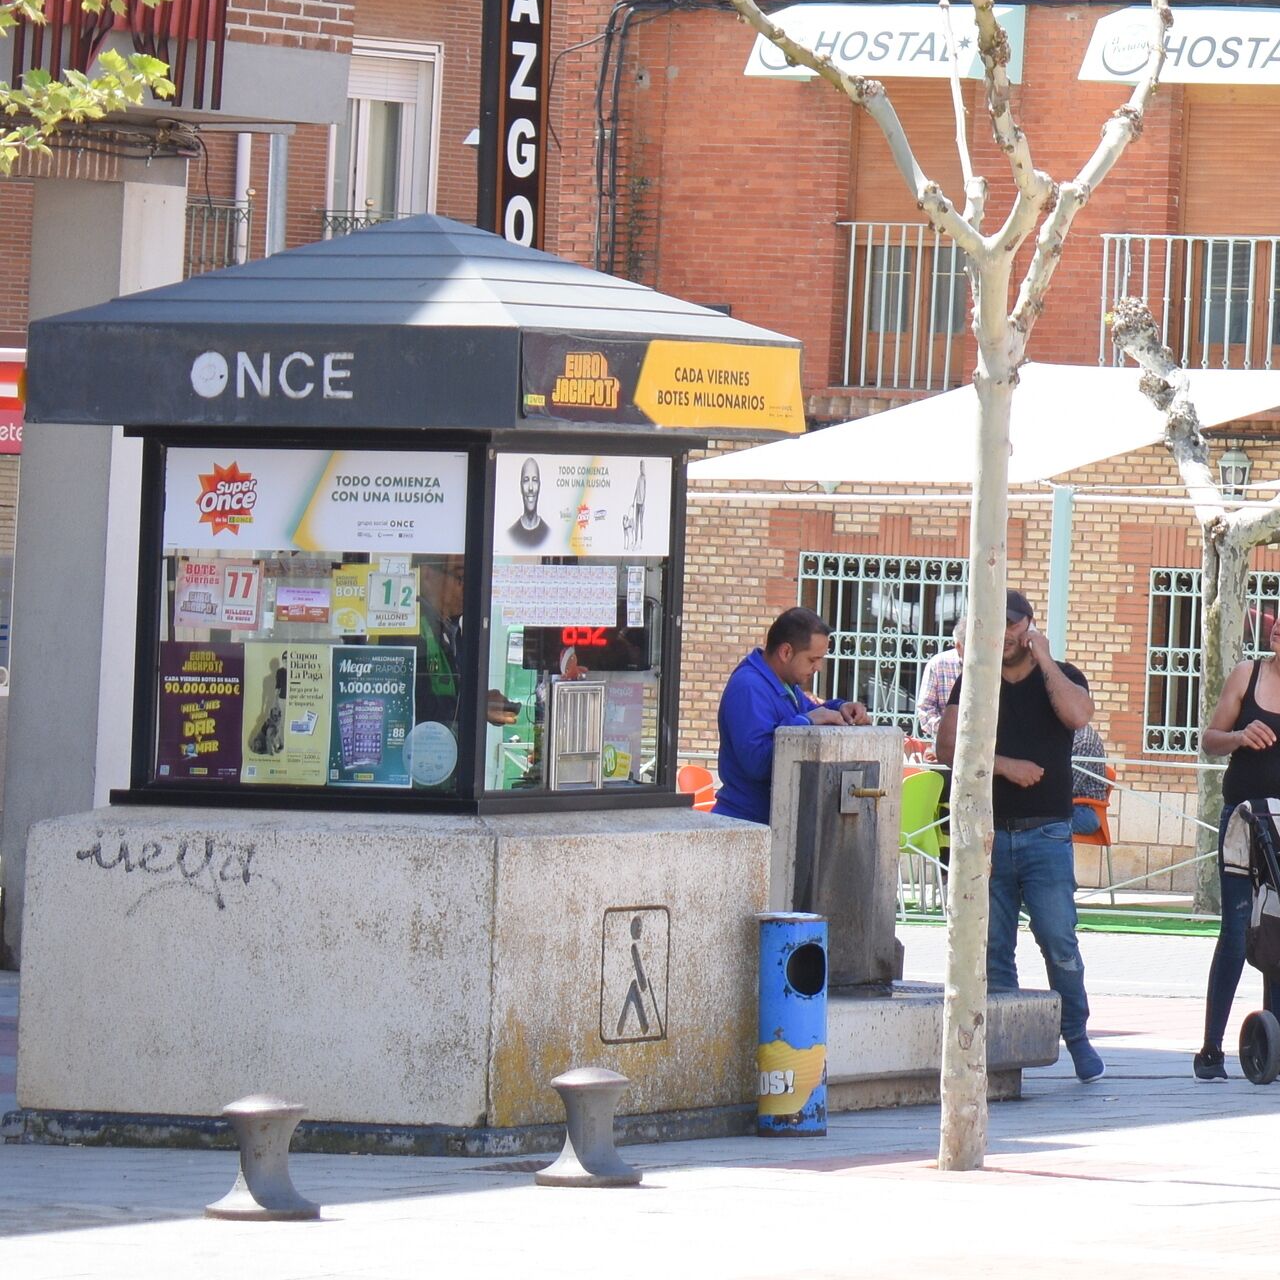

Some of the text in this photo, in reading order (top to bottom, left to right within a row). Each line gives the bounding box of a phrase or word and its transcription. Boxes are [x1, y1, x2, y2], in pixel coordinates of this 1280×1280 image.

[566, 352, 605, 378] EURO
[190, 350, 354, 399] ONCE
[674, 366, 750, 387] CADA VIERNES
[552, 377, 617, 408] JACKPOT
[657, 389, 765, 411] BOTES MILLONARIOS
[558, 465, 610, 476] TODO COMIENZA
[216, 480, 257, 494] Super
[335, 475, 441, 488] TODO COMIENZA
[556, 478, 570, 488] CON
[571, 479, 585, 488] UNA
[200, 491, 257, 513] Once
[331, 489, 444, 504] CON UNA ILUSIÓN
[390, 520, 415, 528] ONCE
[186, 564, 217, 576] BOTE
[185, 576, 220, 585] viernes
[227, 571, 253, 599] 77
[335, 586, 366, 597] BOTE
[375, 613, 408, 621] MILLONES
[289, 660, 316, 670] Diario
[339, 659, 372, 677] Mega
[289, 670, 323, 682] La Paga
